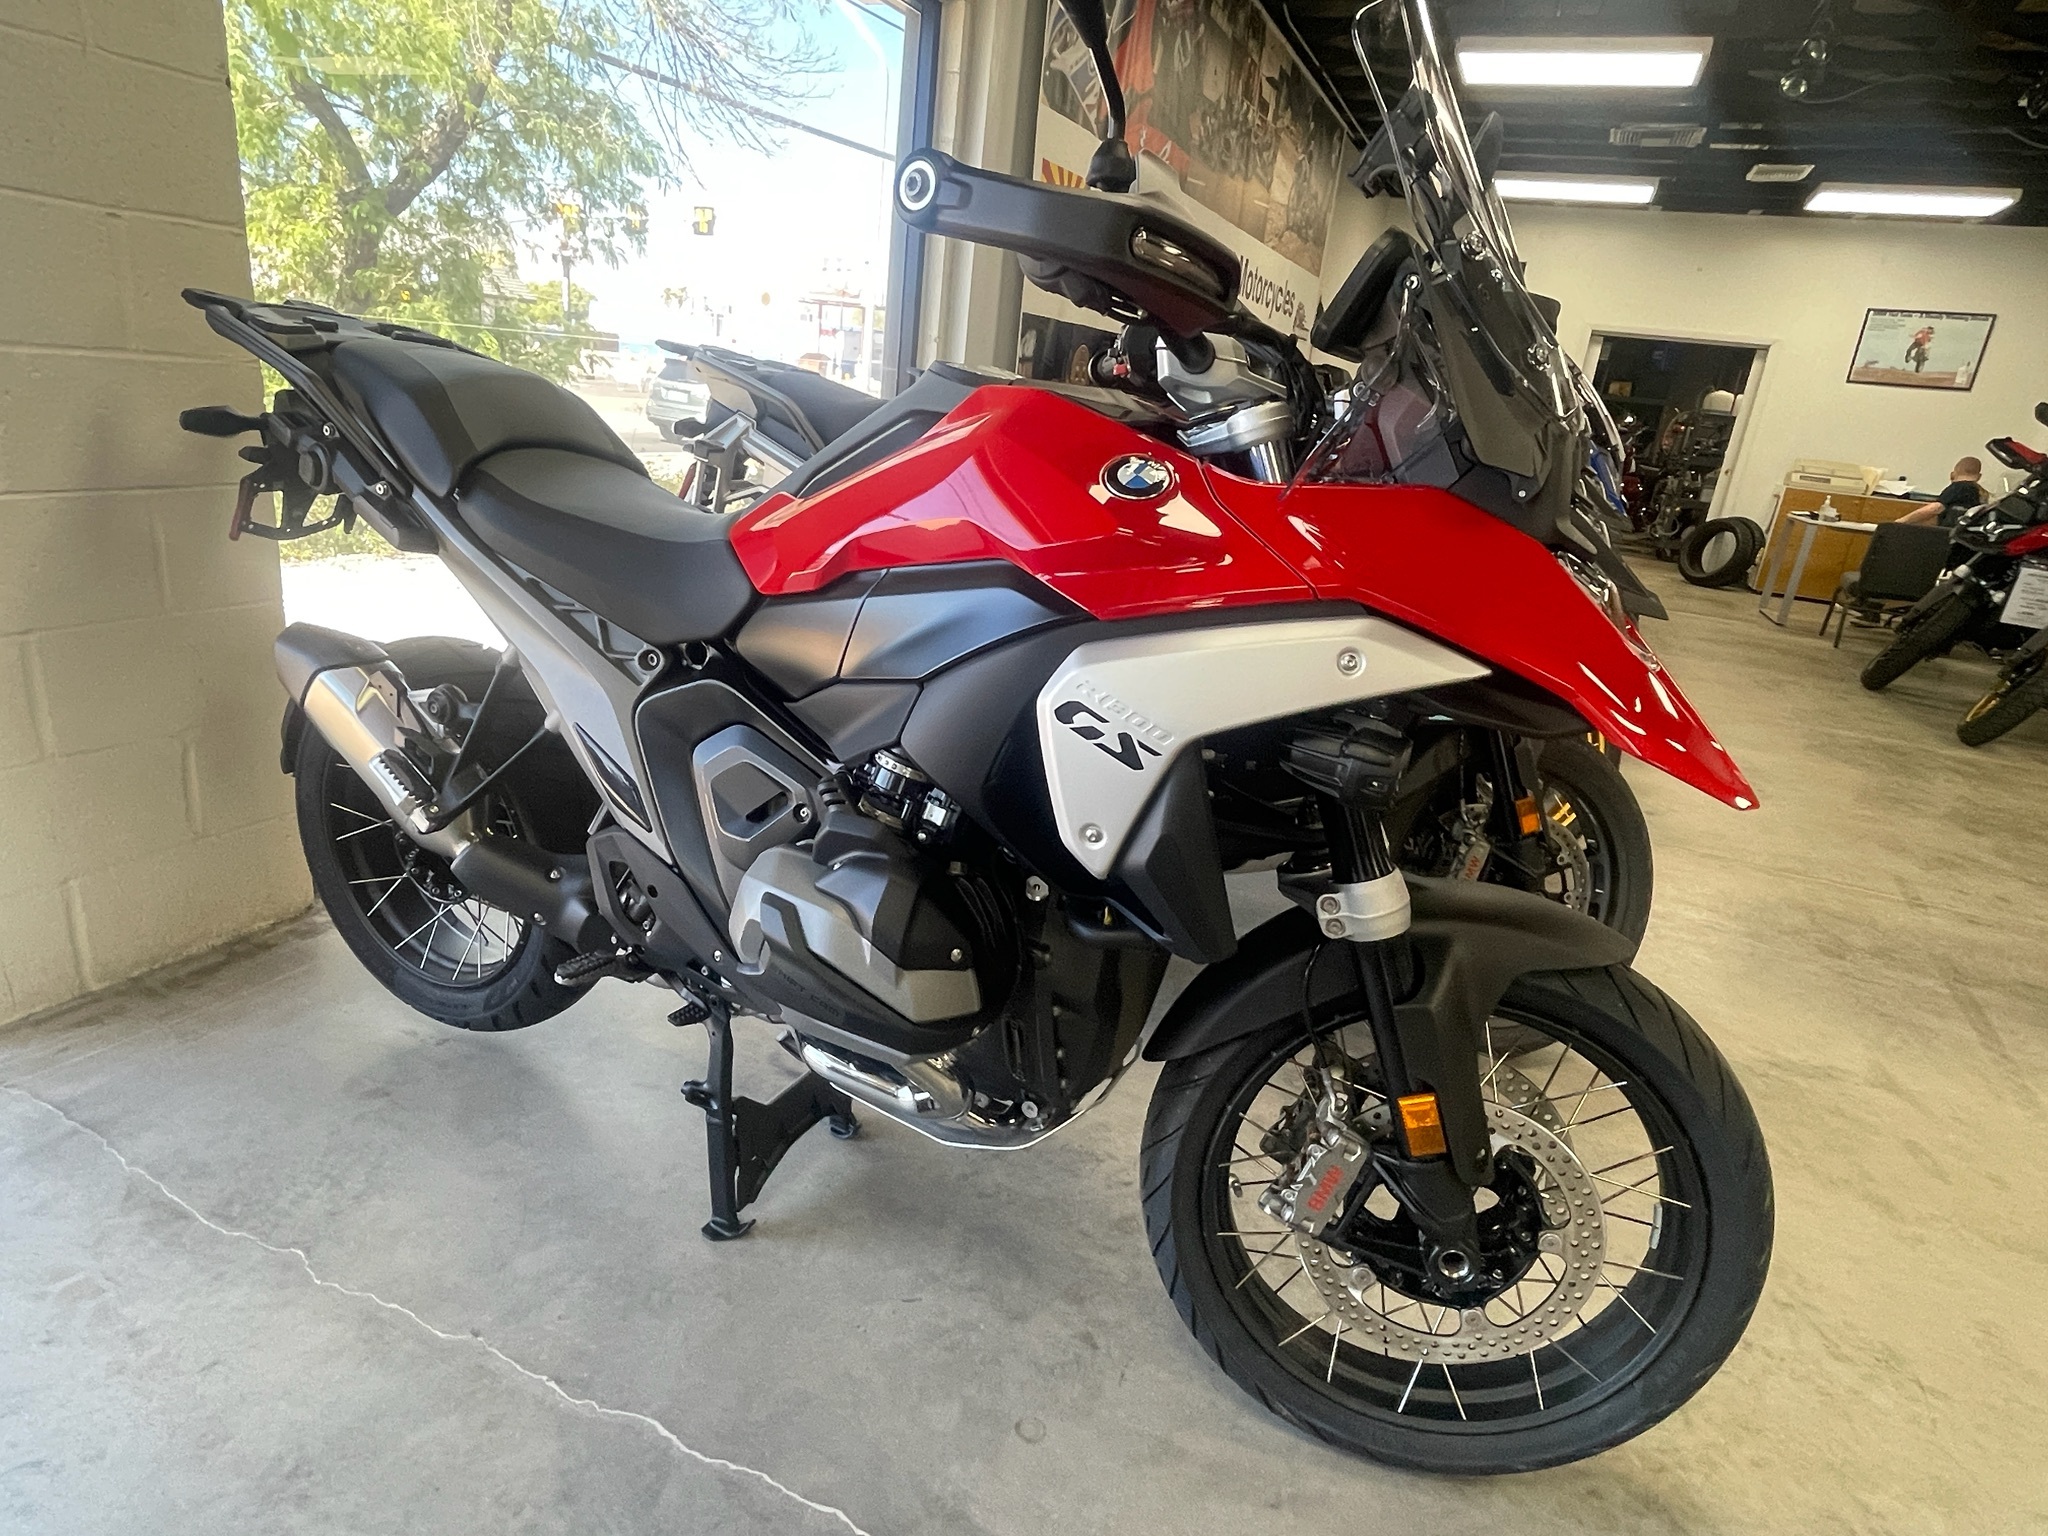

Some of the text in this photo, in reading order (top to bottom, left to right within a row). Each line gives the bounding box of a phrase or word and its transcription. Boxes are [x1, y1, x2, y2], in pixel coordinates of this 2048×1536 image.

[1239, 255, 1296, 318] Motorcycles
[1054, 700, 1163, 771] GS
[1307, 1164, 1344, 1212] BMW
